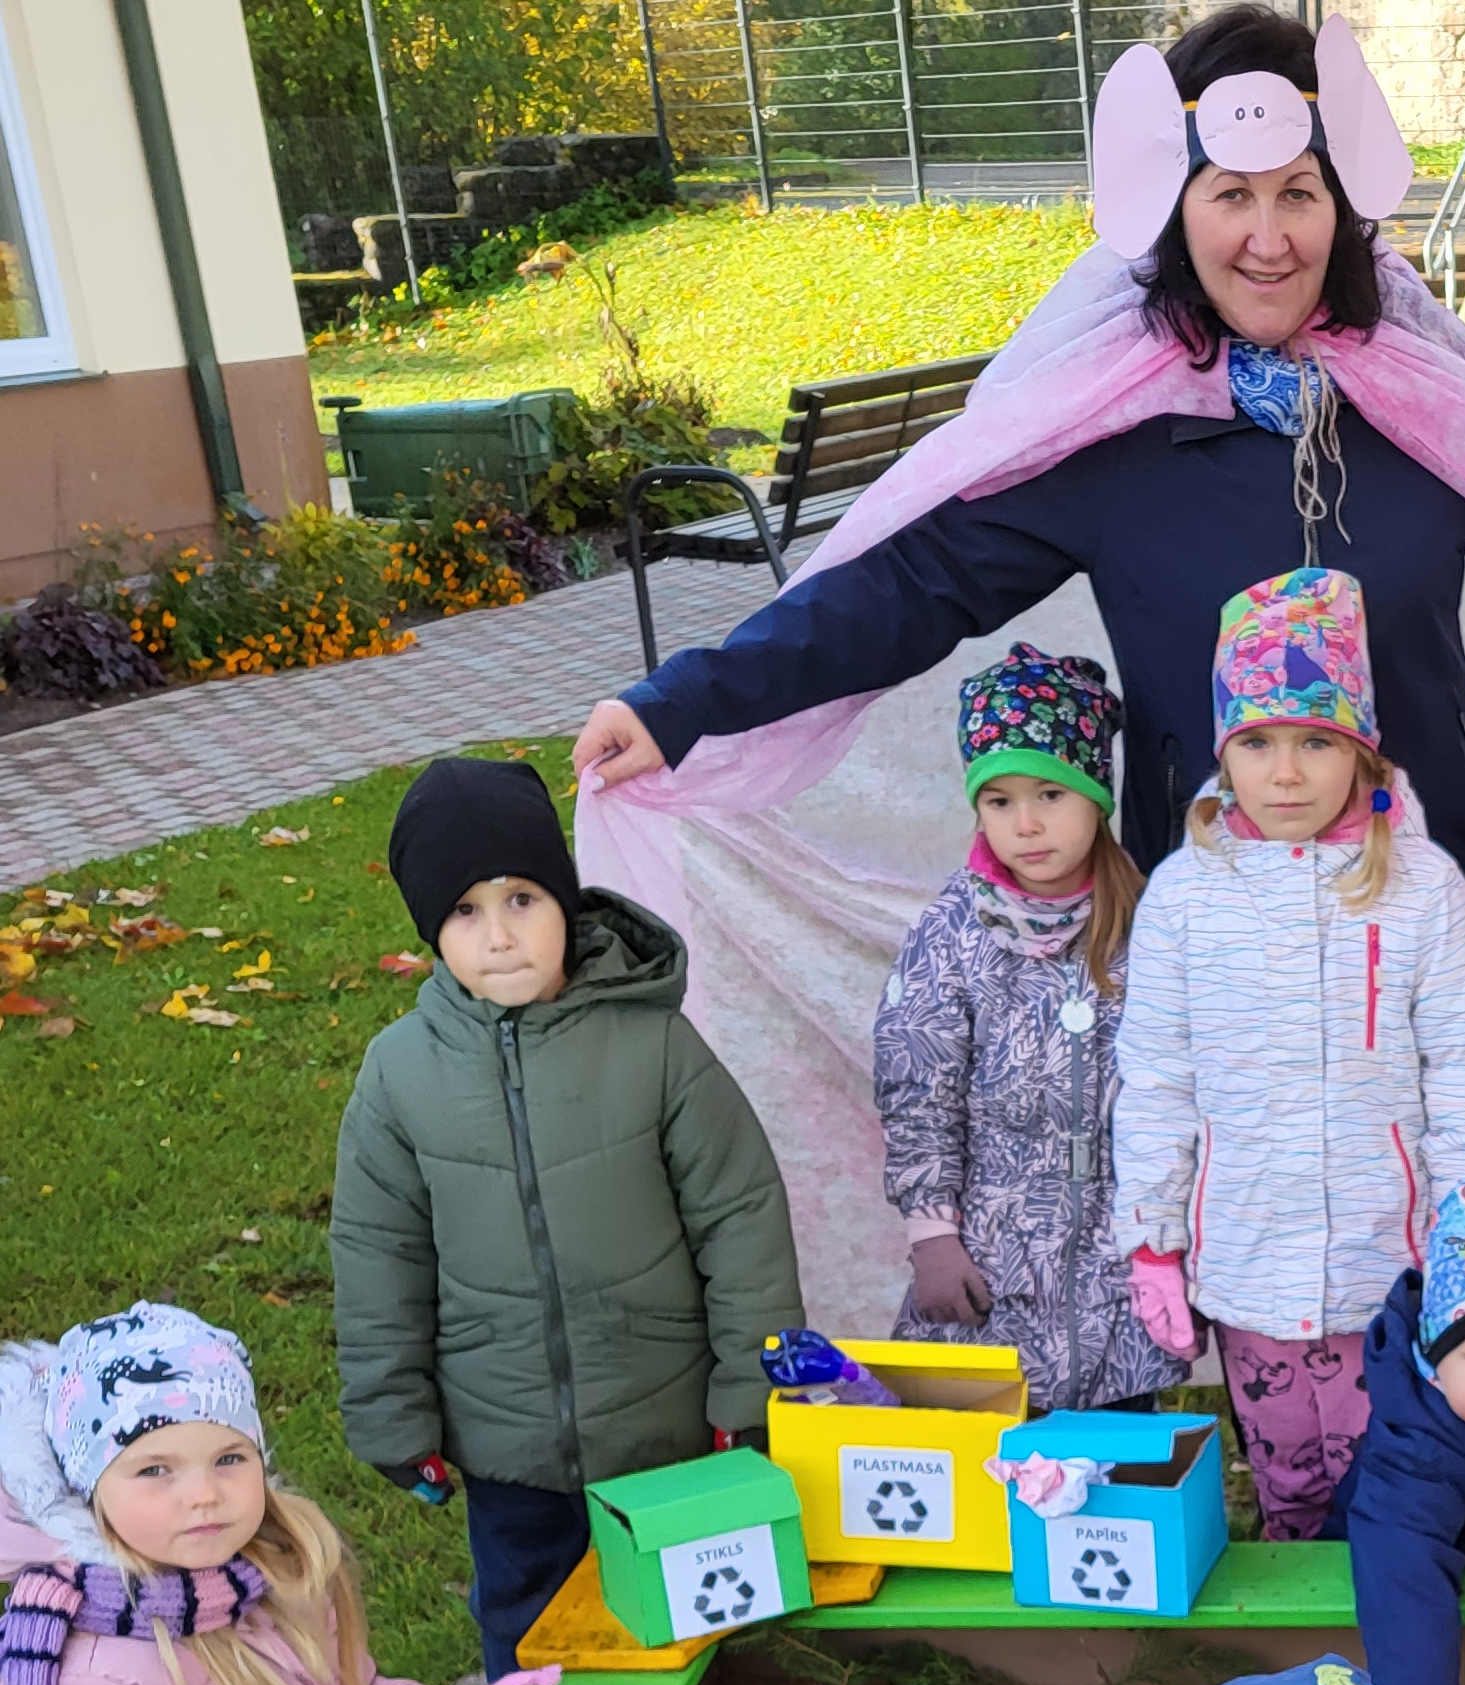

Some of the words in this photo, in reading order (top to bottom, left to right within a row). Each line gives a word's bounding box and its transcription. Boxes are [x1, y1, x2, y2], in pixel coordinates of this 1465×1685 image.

[853, 1458, 945, 1475] PLASTMASA
[1076, 1526, 1128, 1543] PAPĪRS
[695, 1542, 744, 1566] STIKLS
